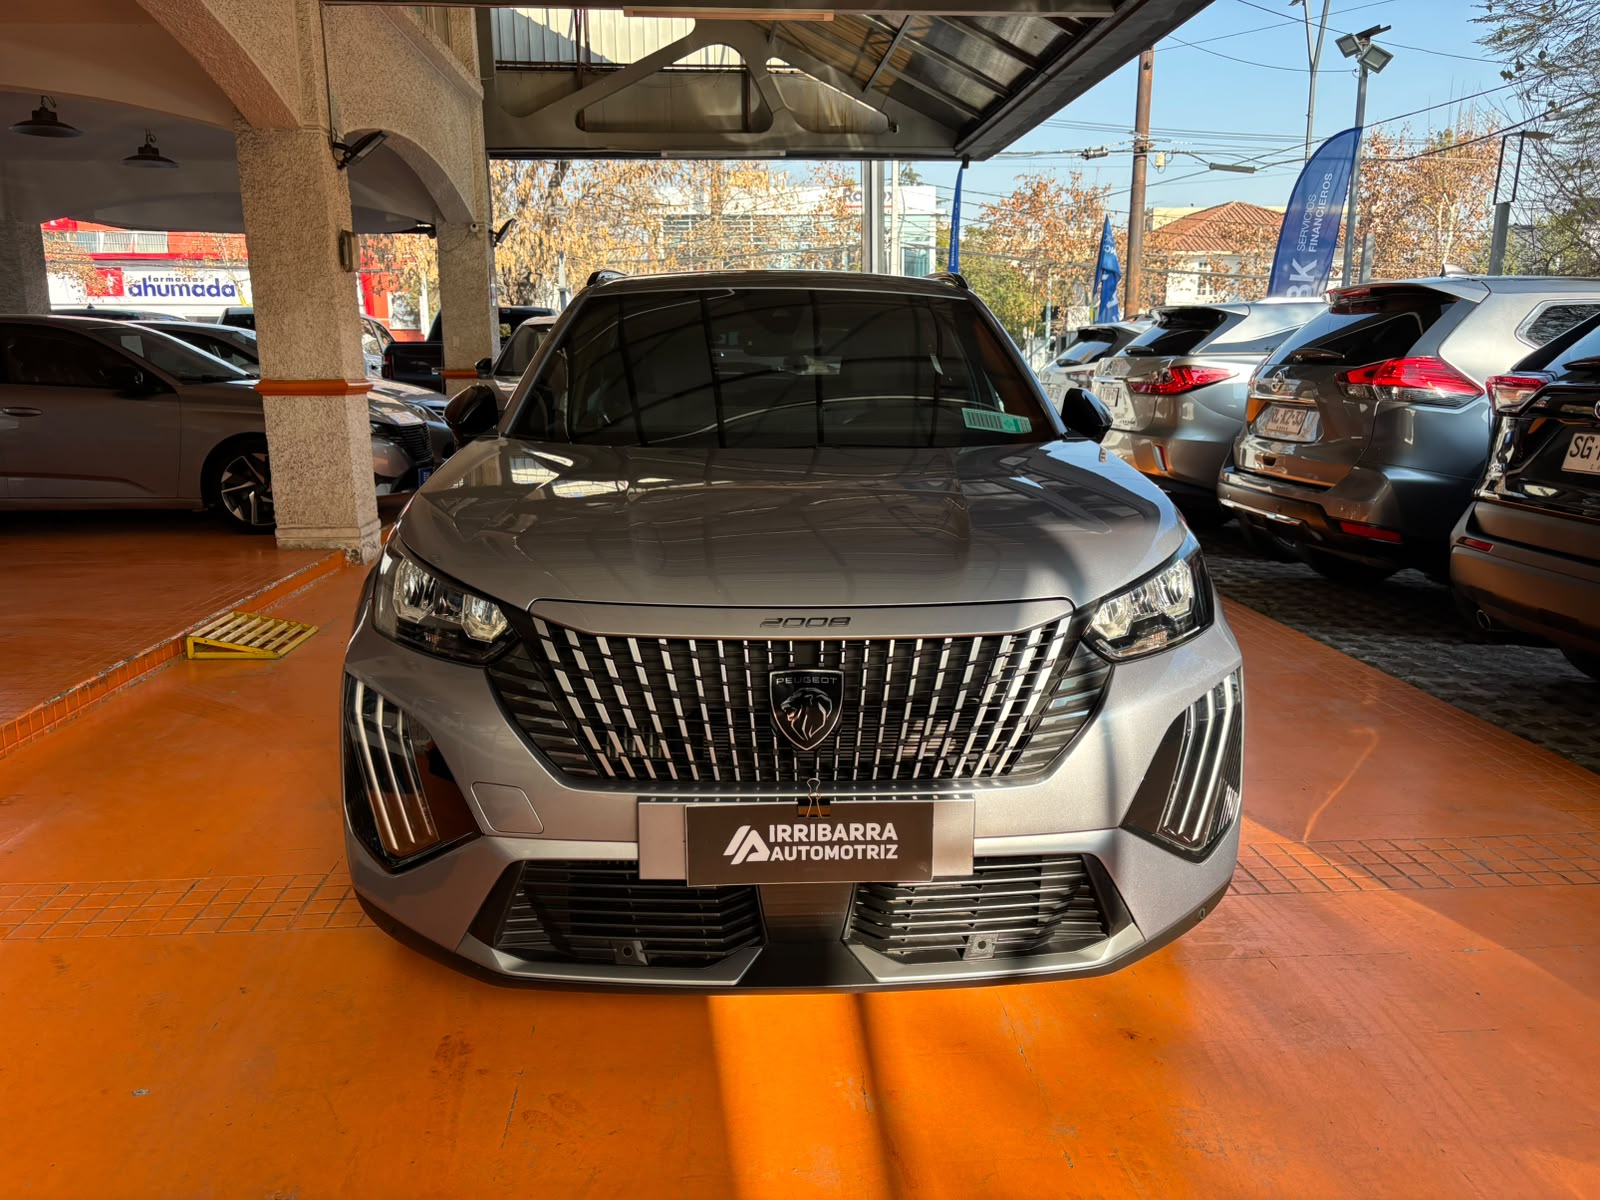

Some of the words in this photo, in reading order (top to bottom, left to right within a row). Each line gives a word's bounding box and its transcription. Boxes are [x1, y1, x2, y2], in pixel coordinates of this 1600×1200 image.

[1297, 194, 1317, 252] SERVICIOS
[1308, 173, 1333, 253] FINANCIEROS
[128, 277, 235, 297] ahumada
[760, 617, 851, 629] 2008
[776, 676, 838, 685] PEUGEOT
[769, 822, 898, 843] IRRIBARRA
[770, 844, 898, 862] AUTOMOTRIZ
